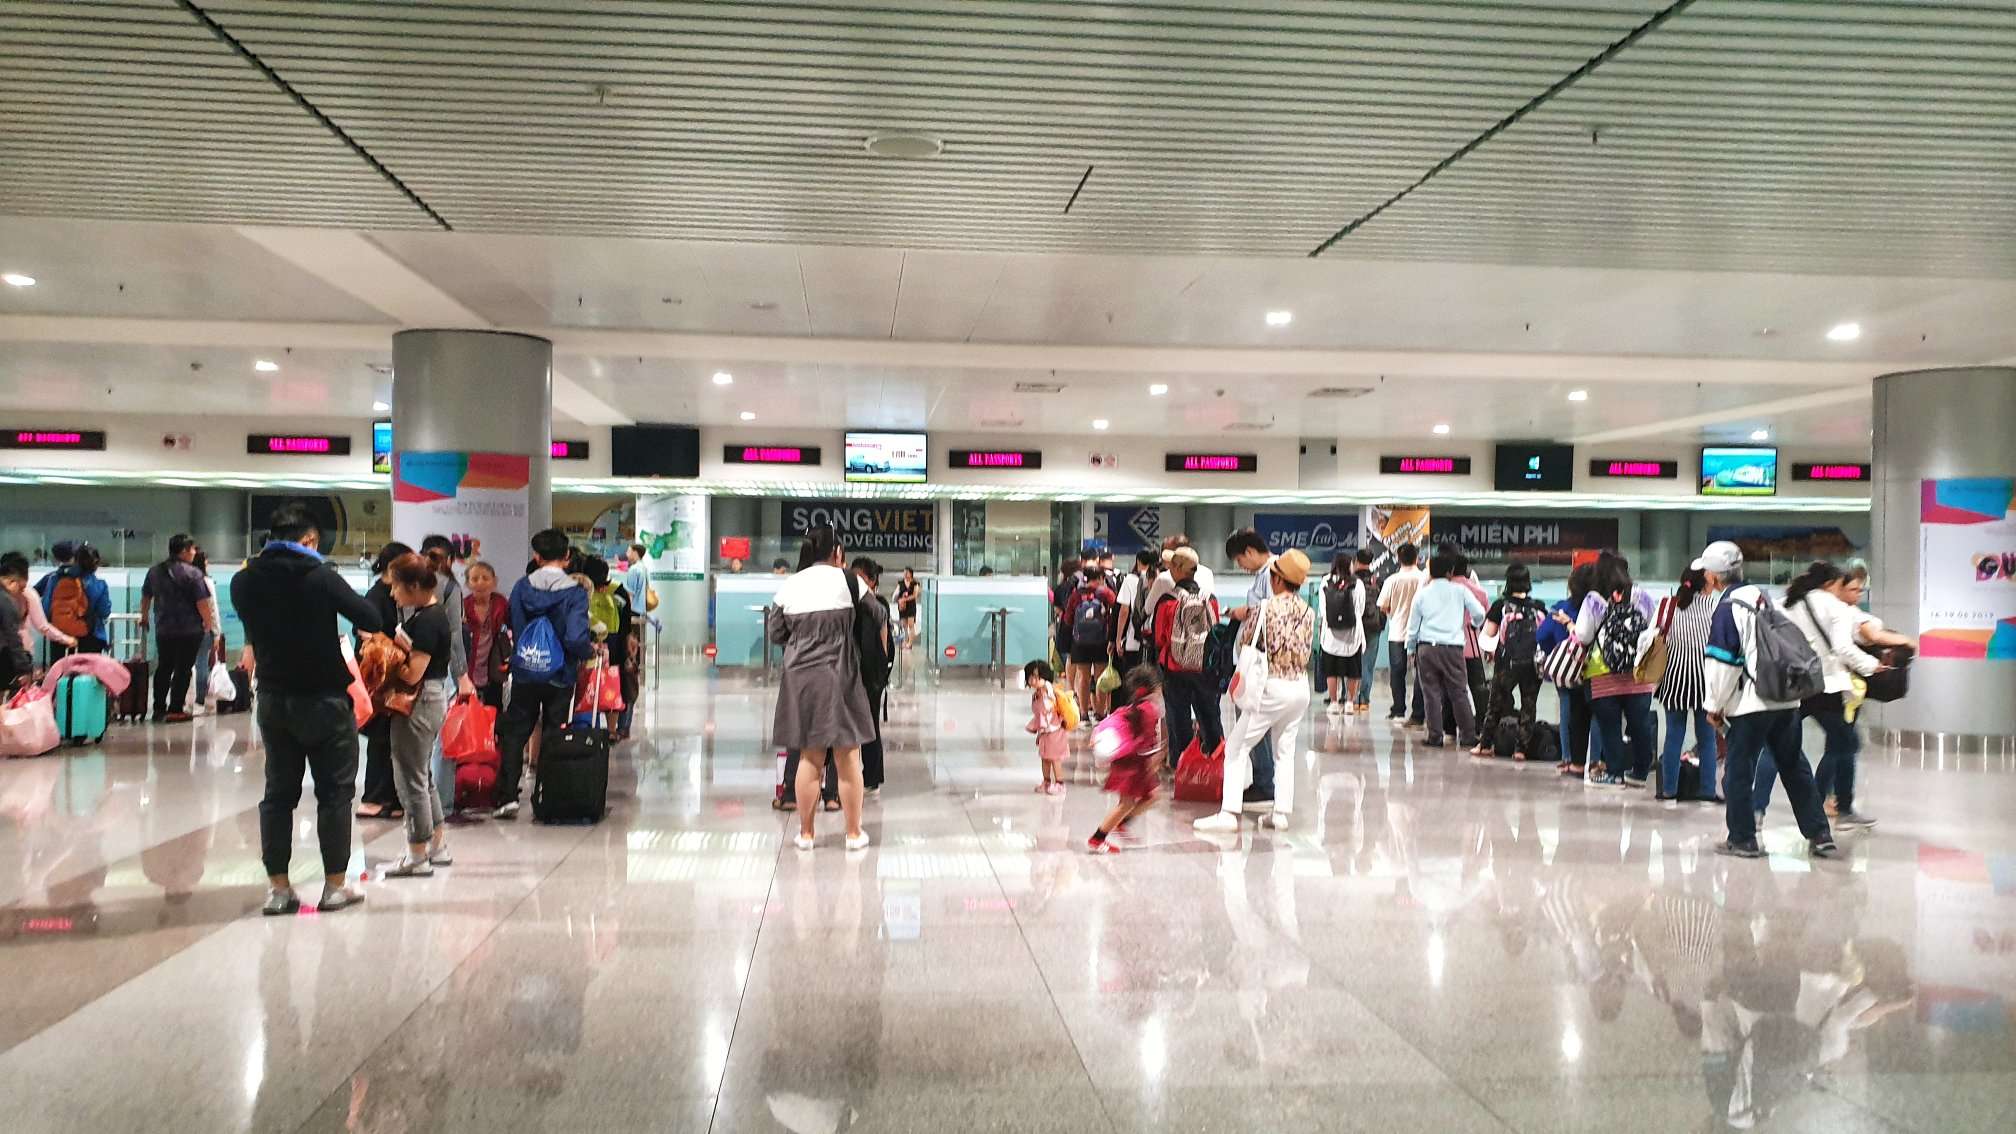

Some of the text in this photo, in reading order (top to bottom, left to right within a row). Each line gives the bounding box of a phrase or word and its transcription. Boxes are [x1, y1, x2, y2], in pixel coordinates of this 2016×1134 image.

[968, 453, 1023, 466] ALL PASSPORTS
[1184, 456, 1199, 470] ALL
[1269, 530, 1308, 547] SME
